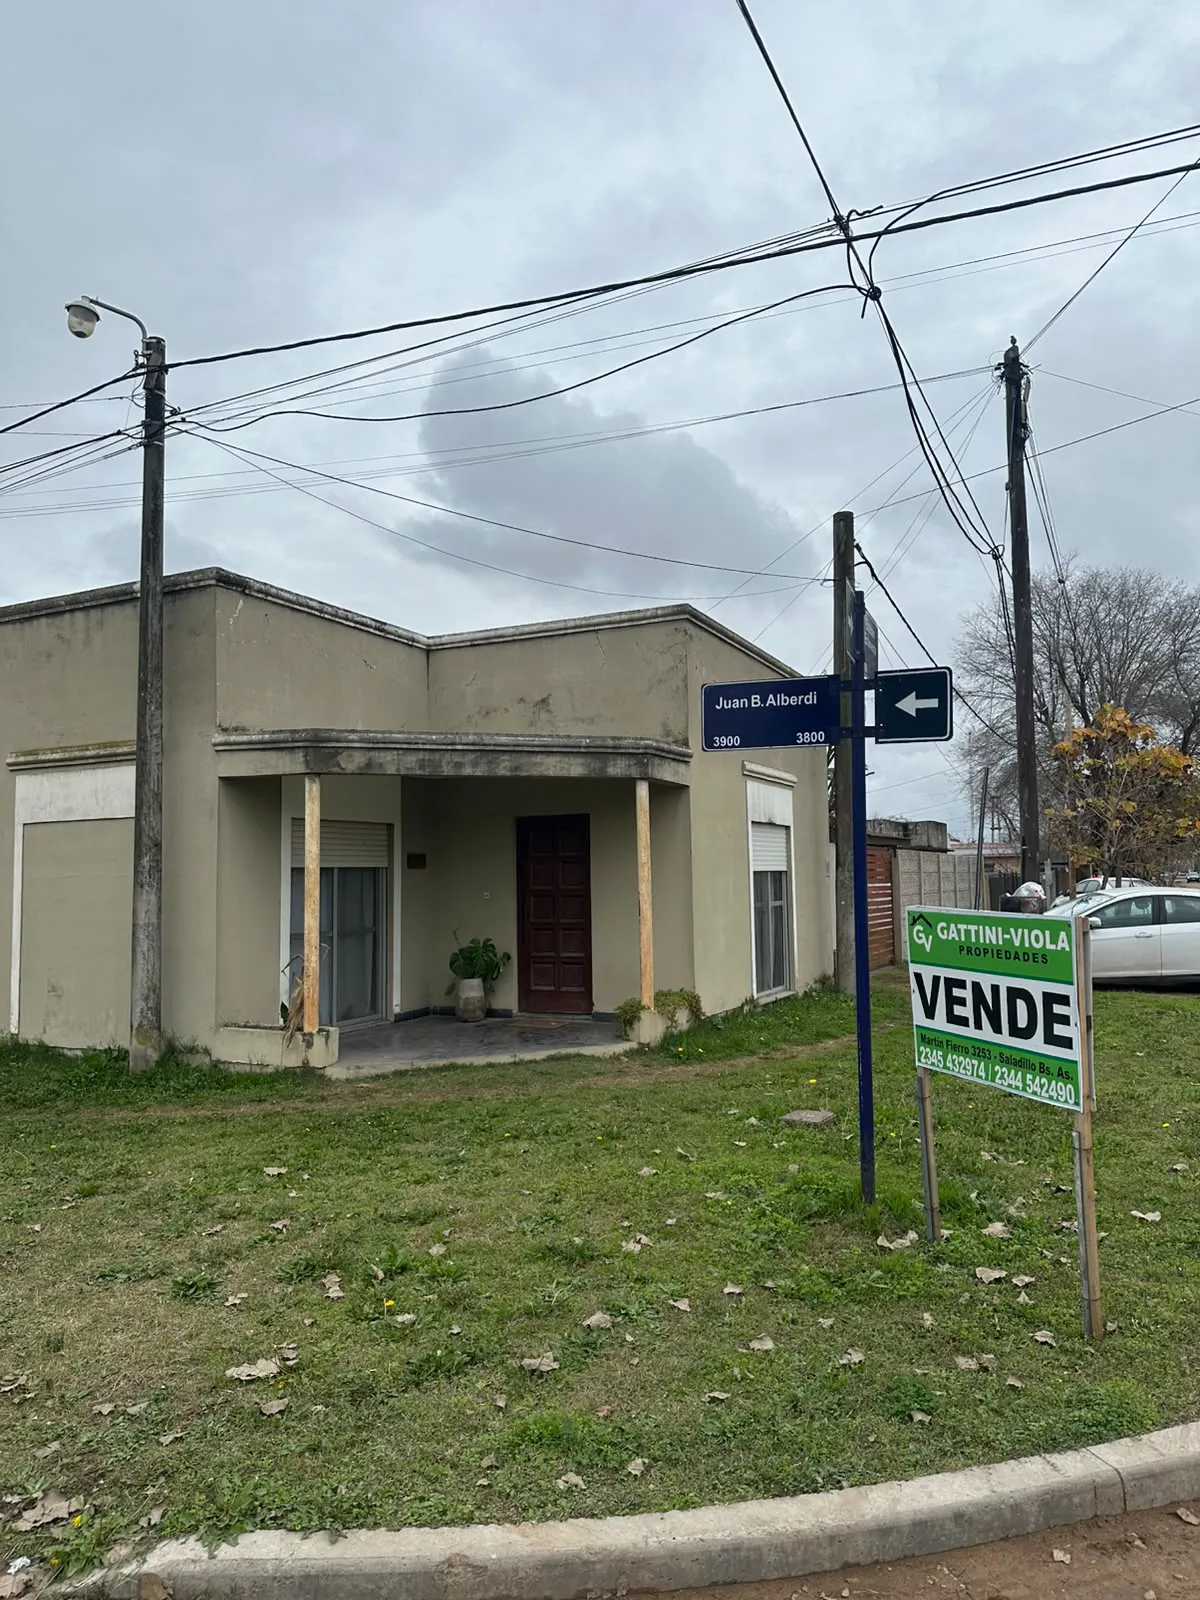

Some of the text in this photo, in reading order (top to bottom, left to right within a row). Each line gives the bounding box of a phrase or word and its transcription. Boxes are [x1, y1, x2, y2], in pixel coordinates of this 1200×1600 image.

[715, 696, 748, 710] Juan
[765, 692, 817, 707] Alberdi
[713, 735, 740, 747] 3900
[796, 731, 825, 744] 3800
[937, 921, 1070, 951] GATTINI-VIOLA
[959, 944, 1049, 965] PROPIEDADES
[913, 971, 1074, 1050] VENDE
[946, 1039, 969, 1054] Fierro
[971, 1045, 992, 1060] 3253
[999, 1052, 1036, 1072] Saladillo
[1039, 1062, 1054, 1076] Bs.
[1057, 1066, 1073, 1081] As.
[920, 1046, 944, 1068] 2345
[946, 1053, 986, 1079] 432974
[994, 1065, 1023, 1091] 2344
[1026, 1073, 1075, 1105] 542490
